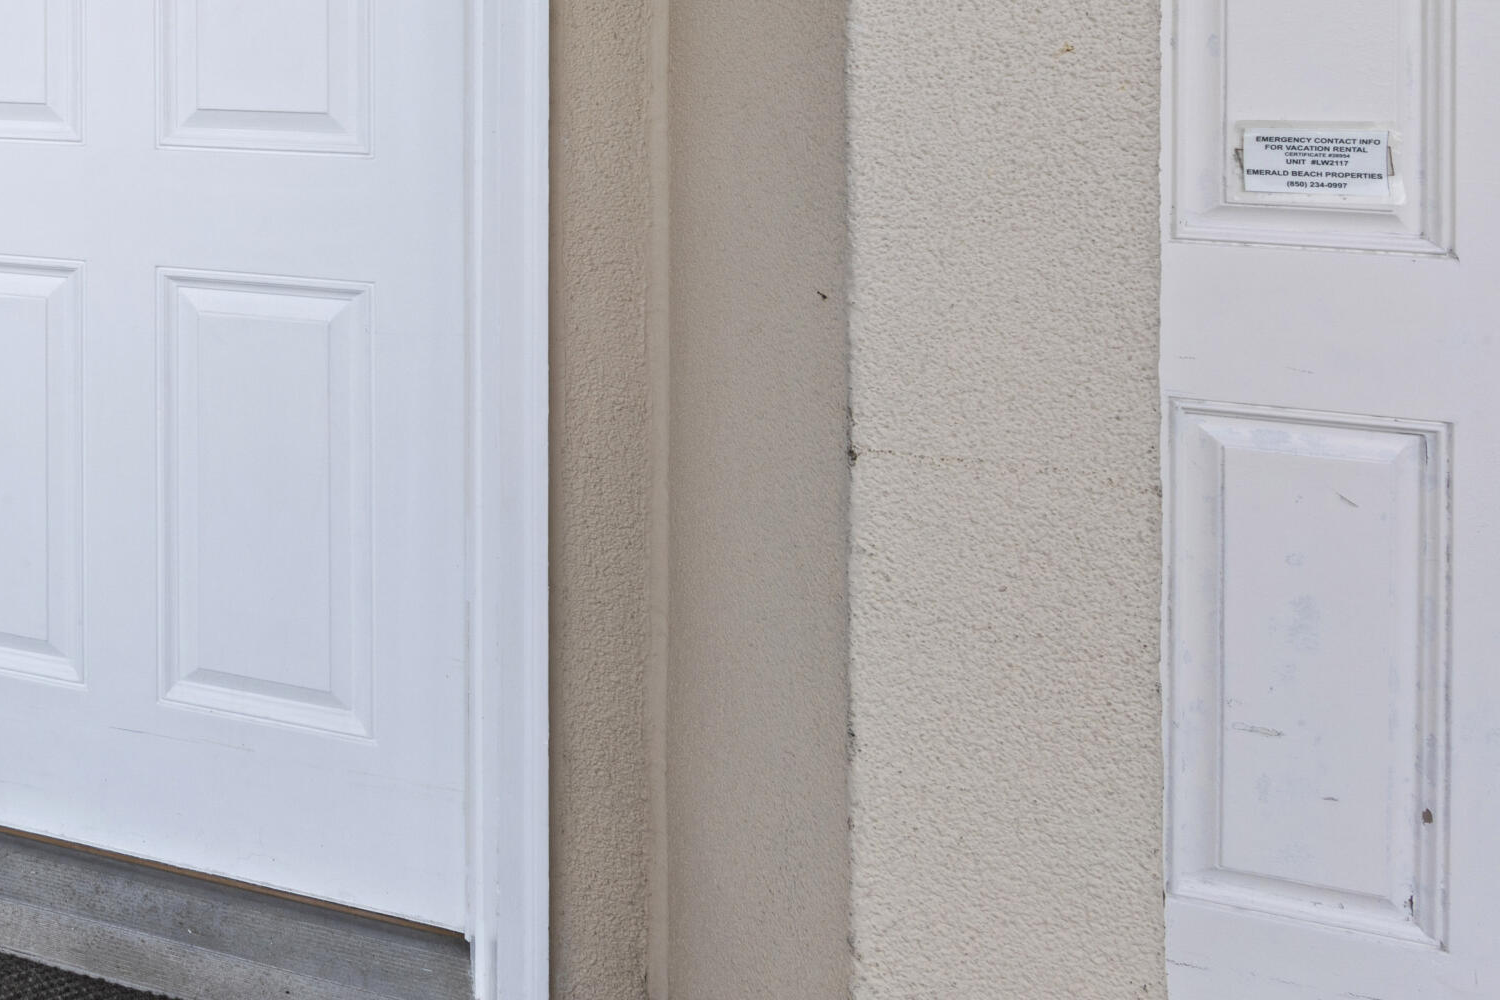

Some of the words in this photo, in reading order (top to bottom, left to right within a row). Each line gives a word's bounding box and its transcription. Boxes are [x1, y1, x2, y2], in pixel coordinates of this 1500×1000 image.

[1255, 136, 1312, 144] EMERGENCY
[1314, 137, 1357, 145] CONTACT
[1246, 168, 1289, 177] EMERALD
[1291, 170, 1323, 178] BEACH
[1325, 171, 1383, 180] PROPERTIES
[1286, 181, 1308, 189] (850)
[1309, 181, 1348, 189] 234-0997
